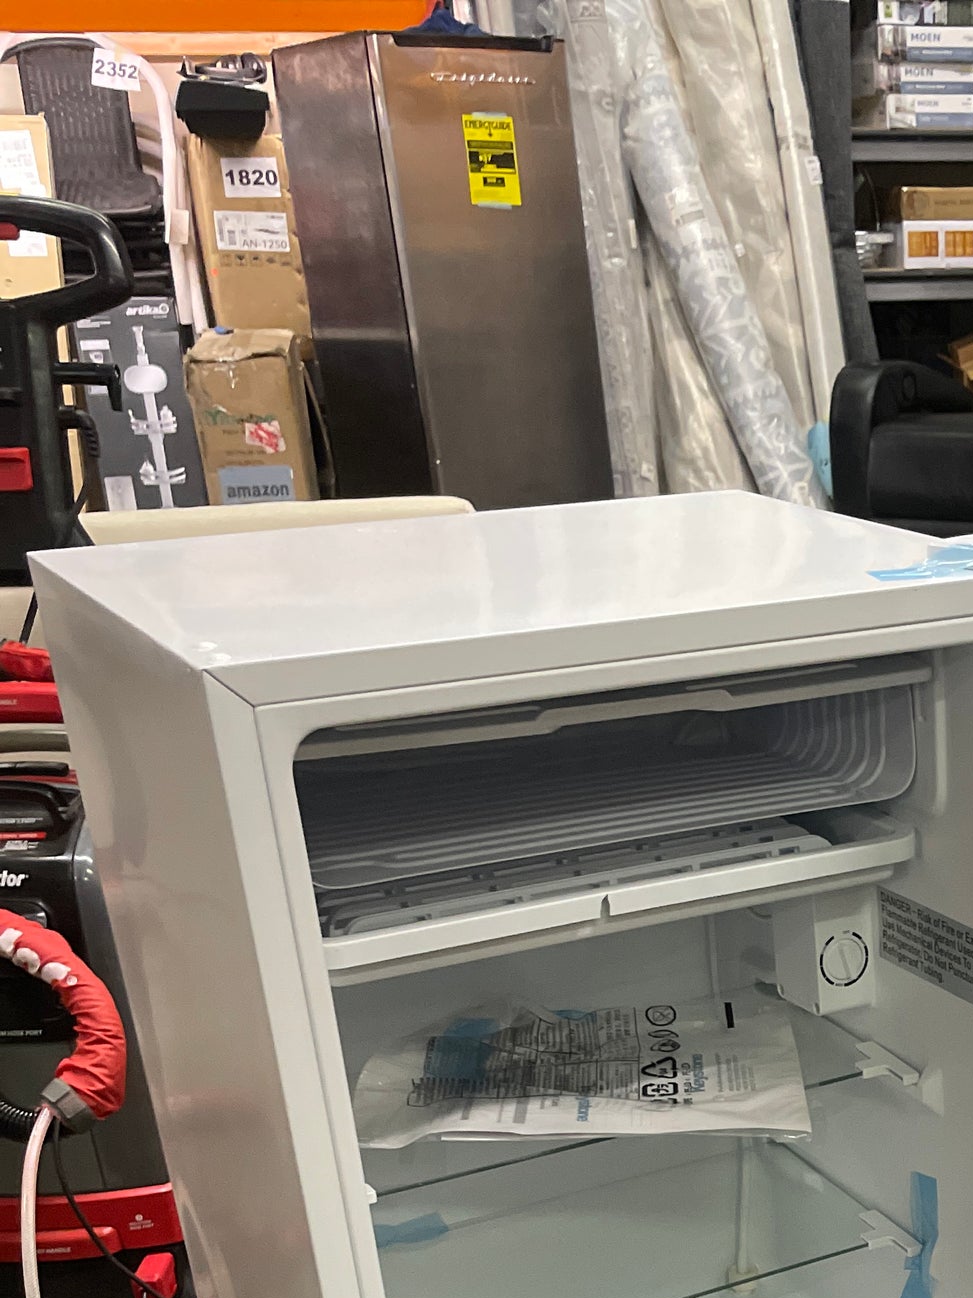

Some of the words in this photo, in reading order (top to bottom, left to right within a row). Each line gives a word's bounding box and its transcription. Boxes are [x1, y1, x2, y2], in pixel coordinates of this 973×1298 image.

[911, 33, 941, 42] MOEN
[94, 59, 138, 79] 2352
[904, 67, 934, 76] MOEN
[225, 169, 278, 186] 1820
[242, 239, 288, 249] AN-1250
[227, 485, 289, 498] amazon
[880, 891, 910, 914] DANGER
[917, 908, 931, 925] Risk
[941, 920, 955, 936] Fire
[923, 950, 933, 964] Do
[934, 956, 946, 971] Not
[962, 957, 970, 969] To
[691, 1053, 708, 1093] Keystone
